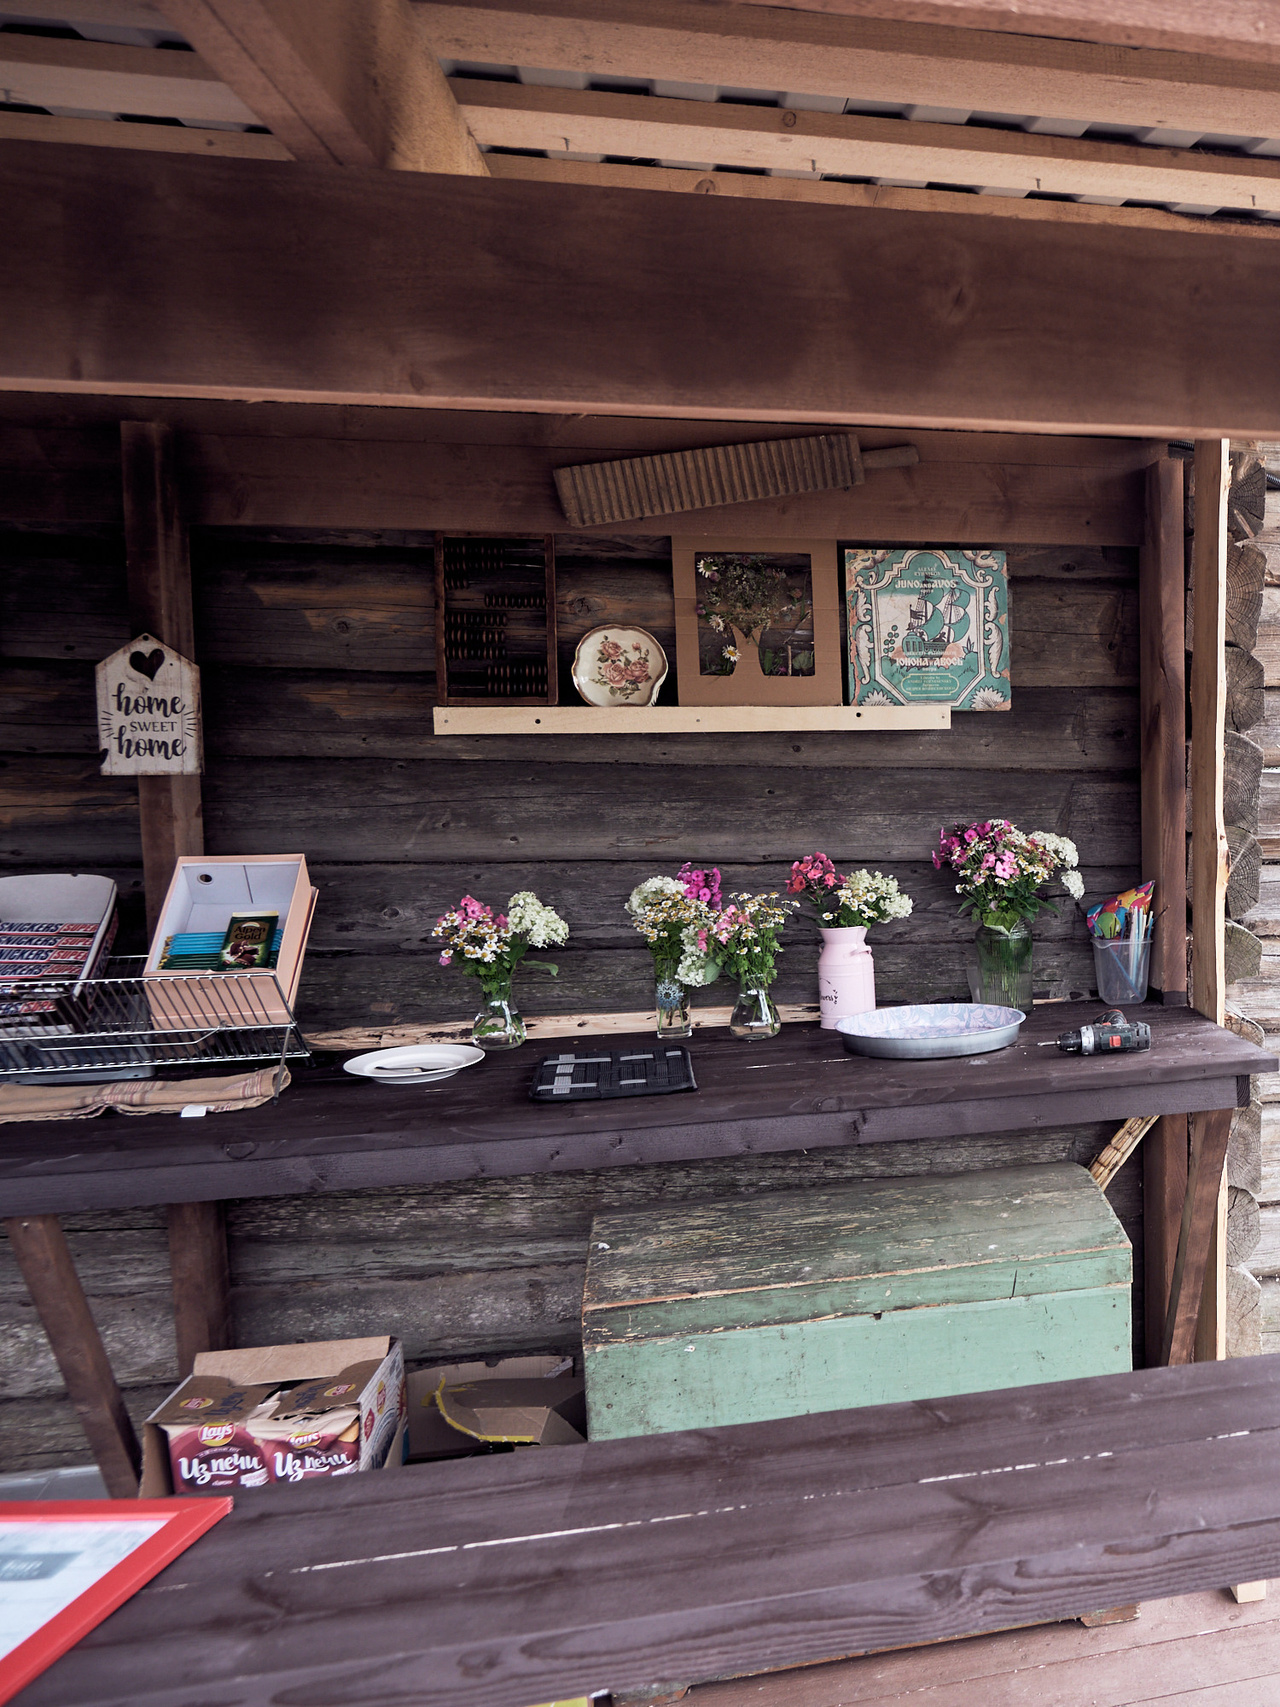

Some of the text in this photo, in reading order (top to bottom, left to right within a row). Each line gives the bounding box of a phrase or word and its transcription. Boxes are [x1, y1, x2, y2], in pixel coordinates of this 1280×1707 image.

[112, 683, 186, 717] home
[130, 721, 178, 732] SWEET
[113, 725, 187, 760] home
[0, 922, 61, 932] SNICKERS
[234, 926, 266, 935] Alpen
[61, 937, 92, 945] SUPE
